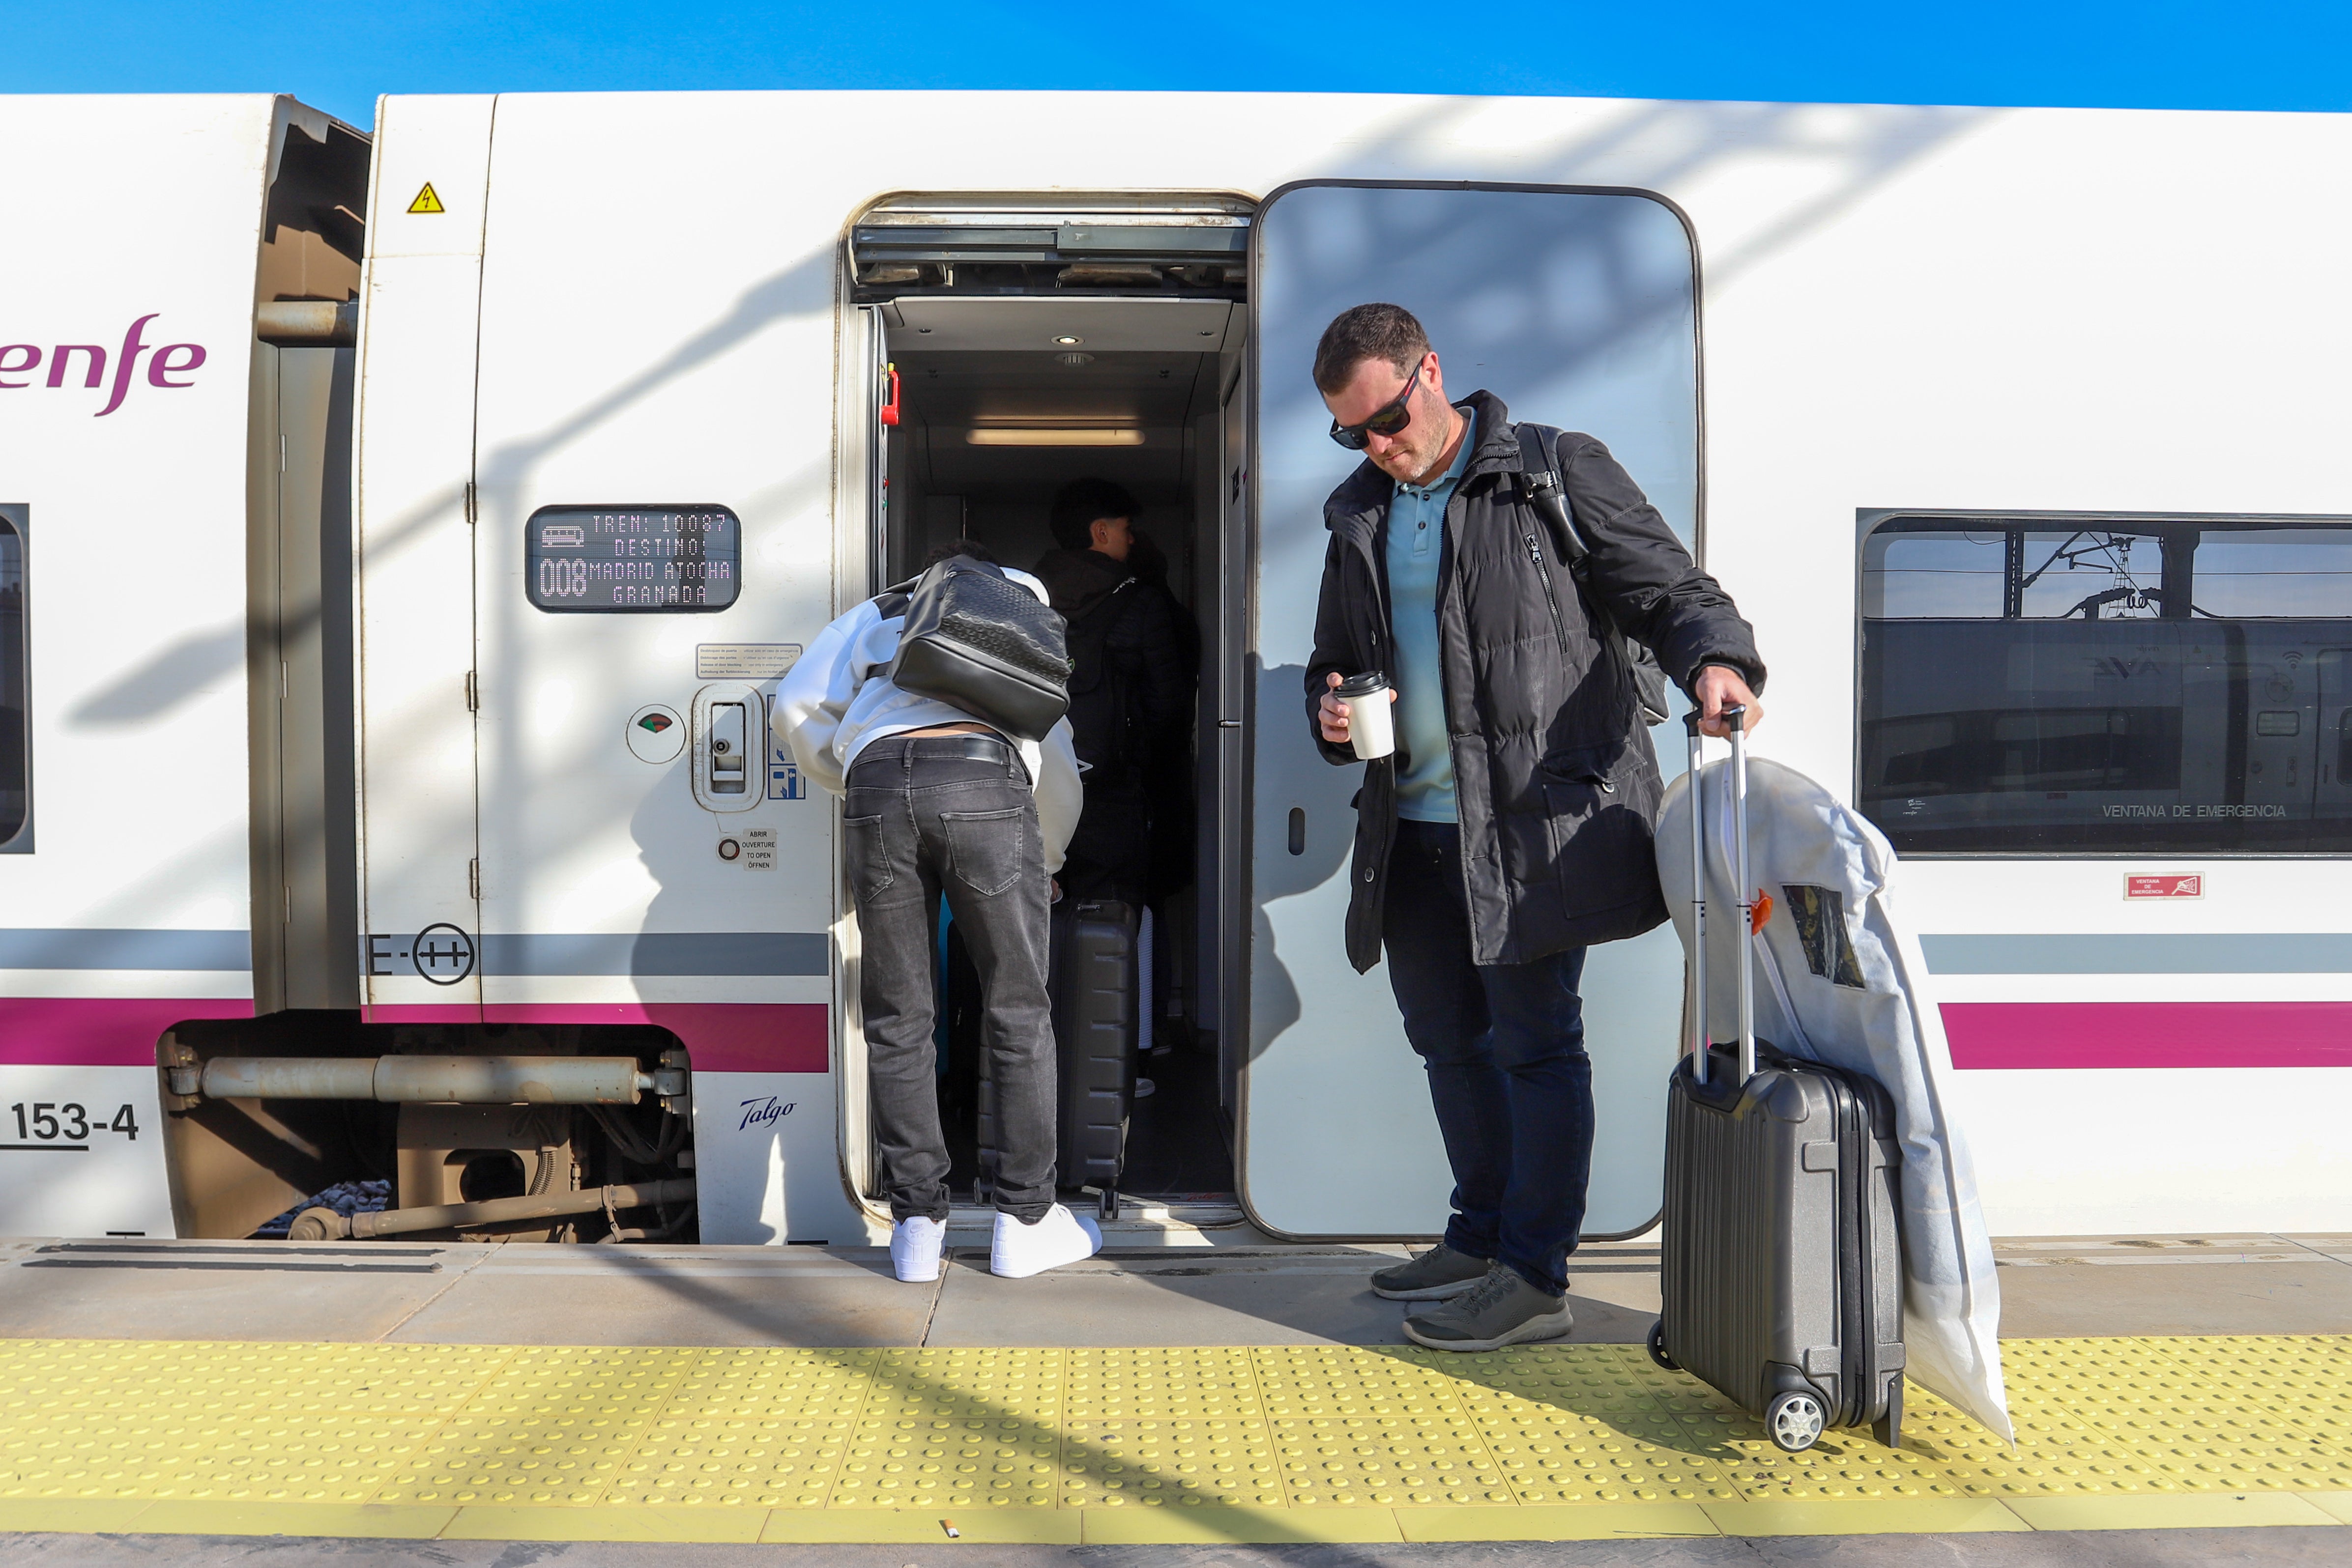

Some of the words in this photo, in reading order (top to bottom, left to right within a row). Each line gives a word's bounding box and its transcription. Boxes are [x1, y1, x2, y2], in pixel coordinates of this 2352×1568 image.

[593, 514, 648, 533] TREN:
[663, 514, 726, 533] 10087
[540, 558, 586, 597] 008
[590, 562, 654, 579] MADRID
[665, 562, 729, 579] ATOCHA
[613, 585, 705, 603] GRANADA
[2102, 805, 2166, 817] VENTANA
[2173, 805, 2191, 817] DE
[2197, 804, 2286, 817] EMERGENCIA
[11, 1103, 139, 1140] 153-4
[738, 1096, 797, 1131] Talgo
